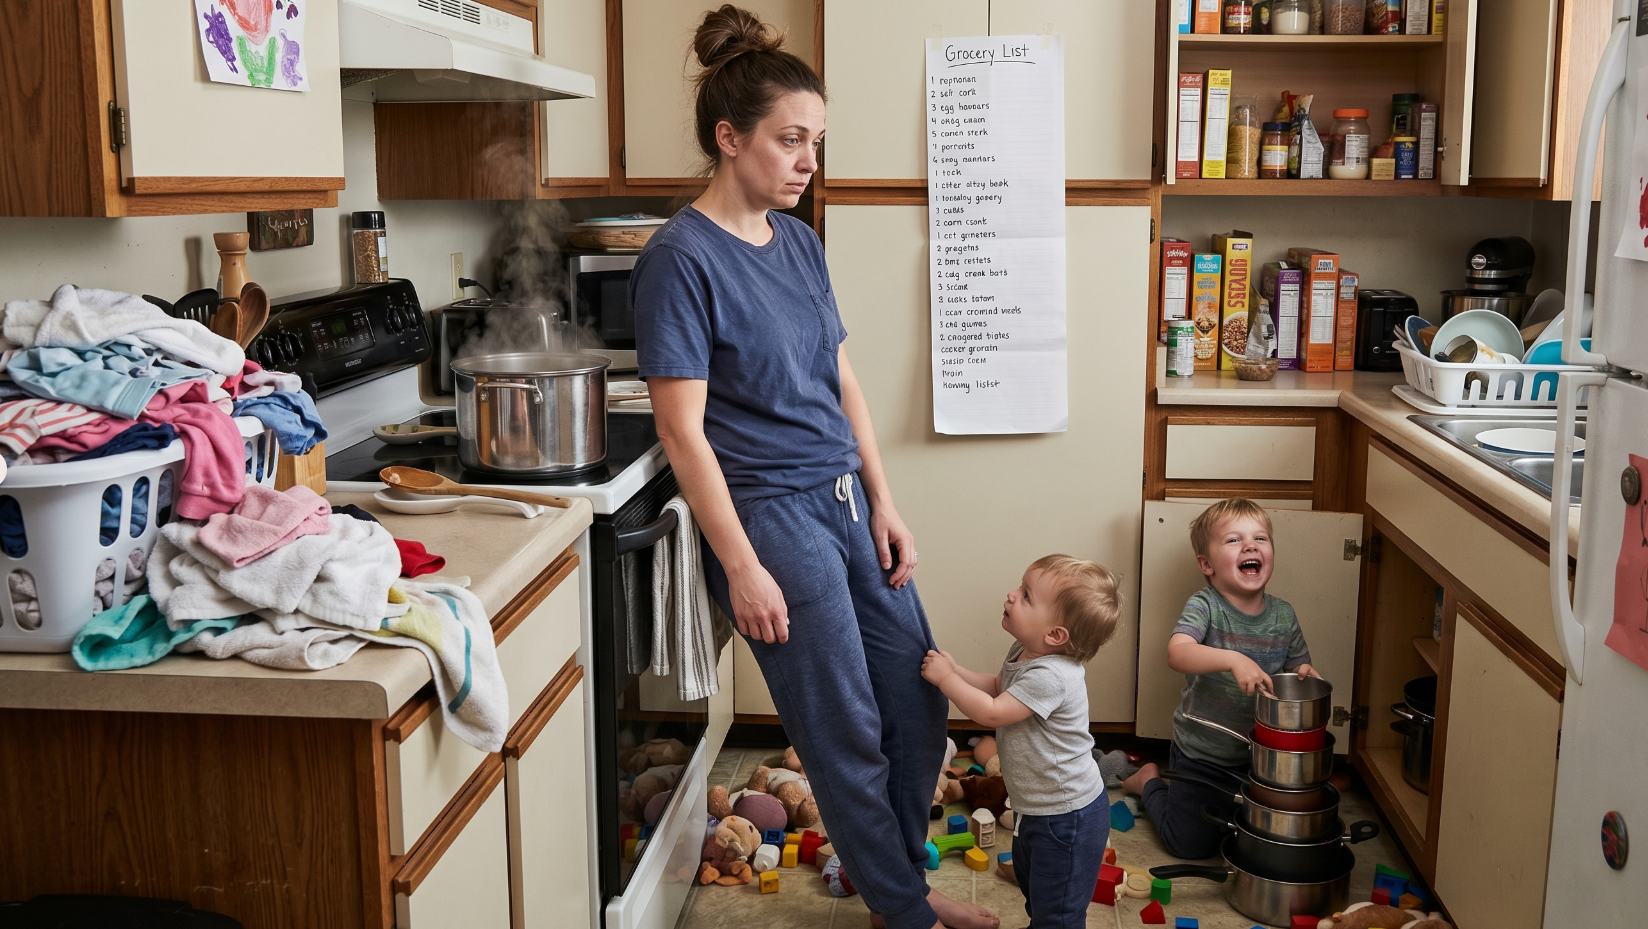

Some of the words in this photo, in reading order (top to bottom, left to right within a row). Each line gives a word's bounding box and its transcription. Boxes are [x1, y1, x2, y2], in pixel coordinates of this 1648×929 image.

[946, 44, 995, 67] Grocery
[1002, 43, 1030, 58] List
[931, 76, 935, 85] 1
[931, 90, 936, 98] 2
[931, 103, 937, 112] 3
[940, 104, 955, 115] egg
[931, 117, 937, 125] 4
[931, 130, 937, 138] 5
[935, 169, 938, 177] 1
[935, 207, 940, 215] 3
[935, 219, 941, 227] 2
[936, 258, 943, 266] 2
[937, 270, 943, 278] 2
[937, 283, 943, 291] 3
[938, 295, 944, 304] 3
[939, 320, 944, 329] 3
[939, 333, 945, 341] 2
